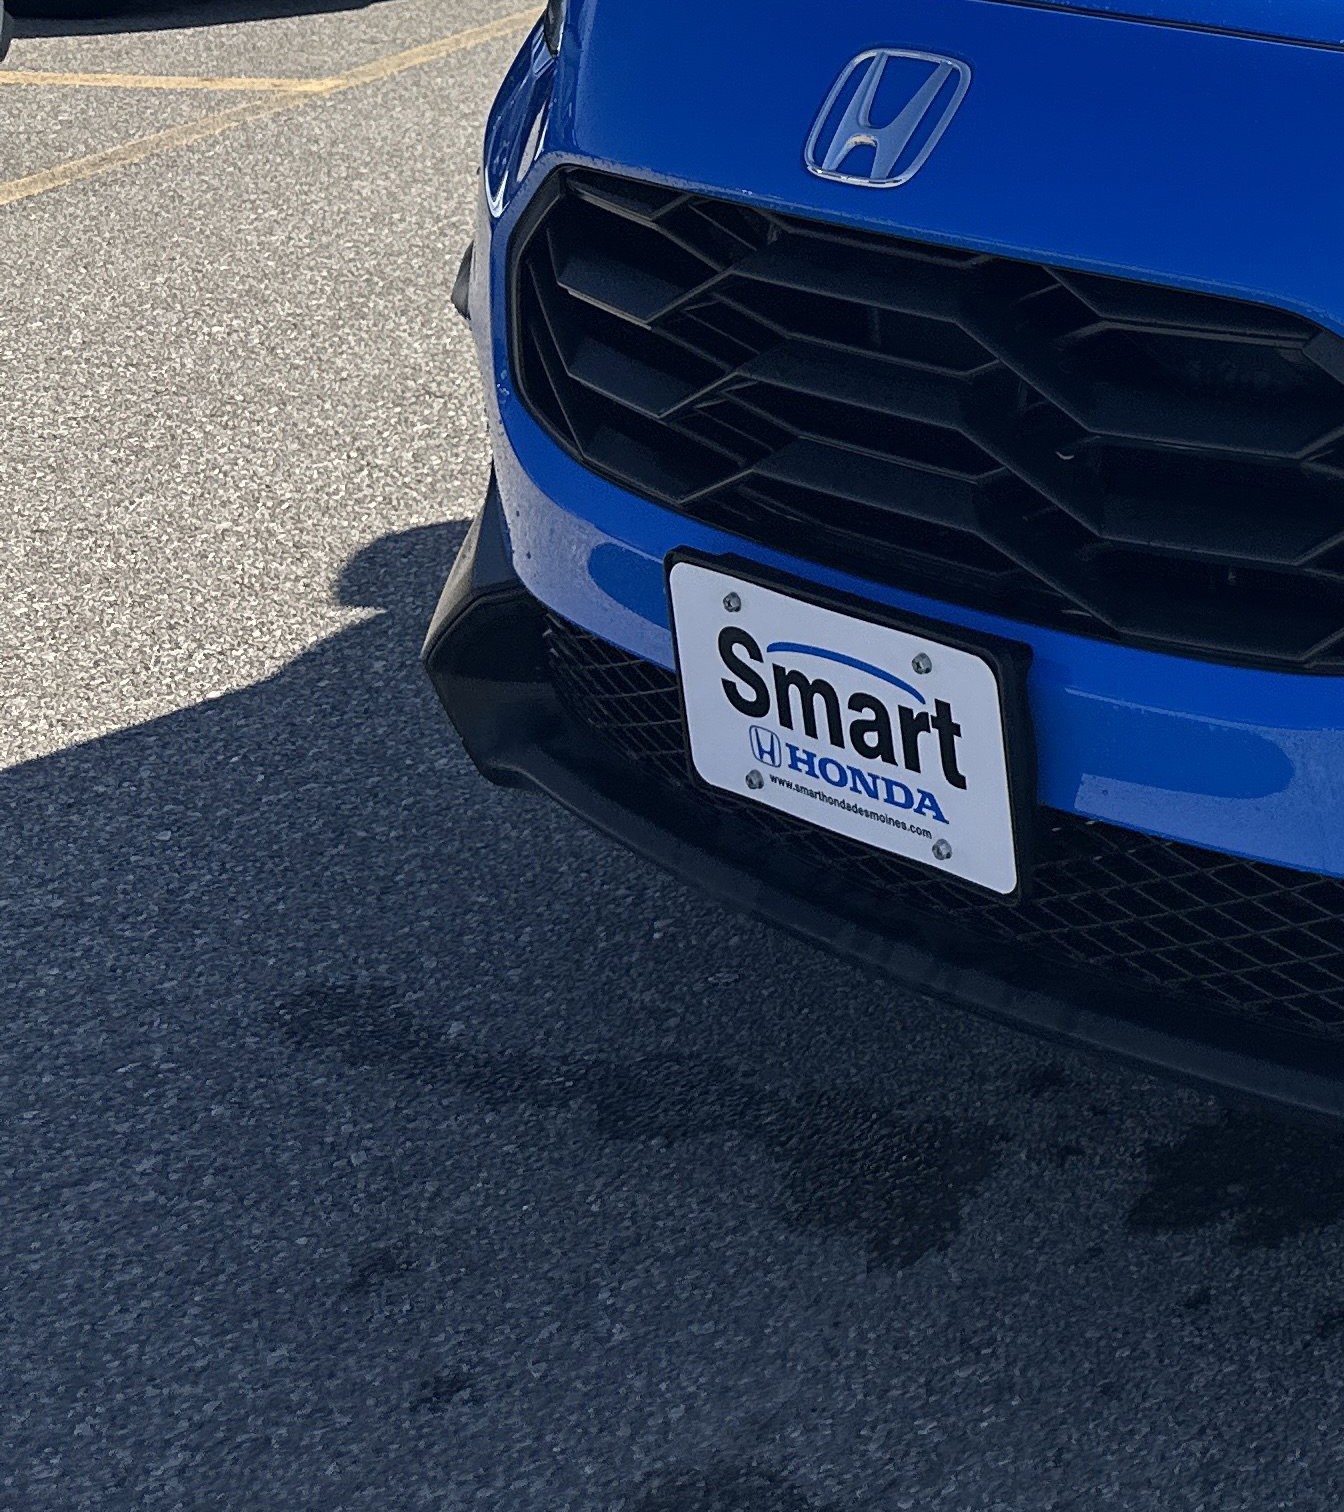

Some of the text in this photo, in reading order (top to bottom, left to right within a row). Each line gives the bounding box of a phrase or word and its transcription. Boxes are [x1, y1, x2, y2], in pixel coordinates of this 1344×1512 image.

[717, 626, 967, 790] Smart
[769, 773, 932, 839] www.smarthondadesmoines.com
[785, 742, 949, 825] HONDA
